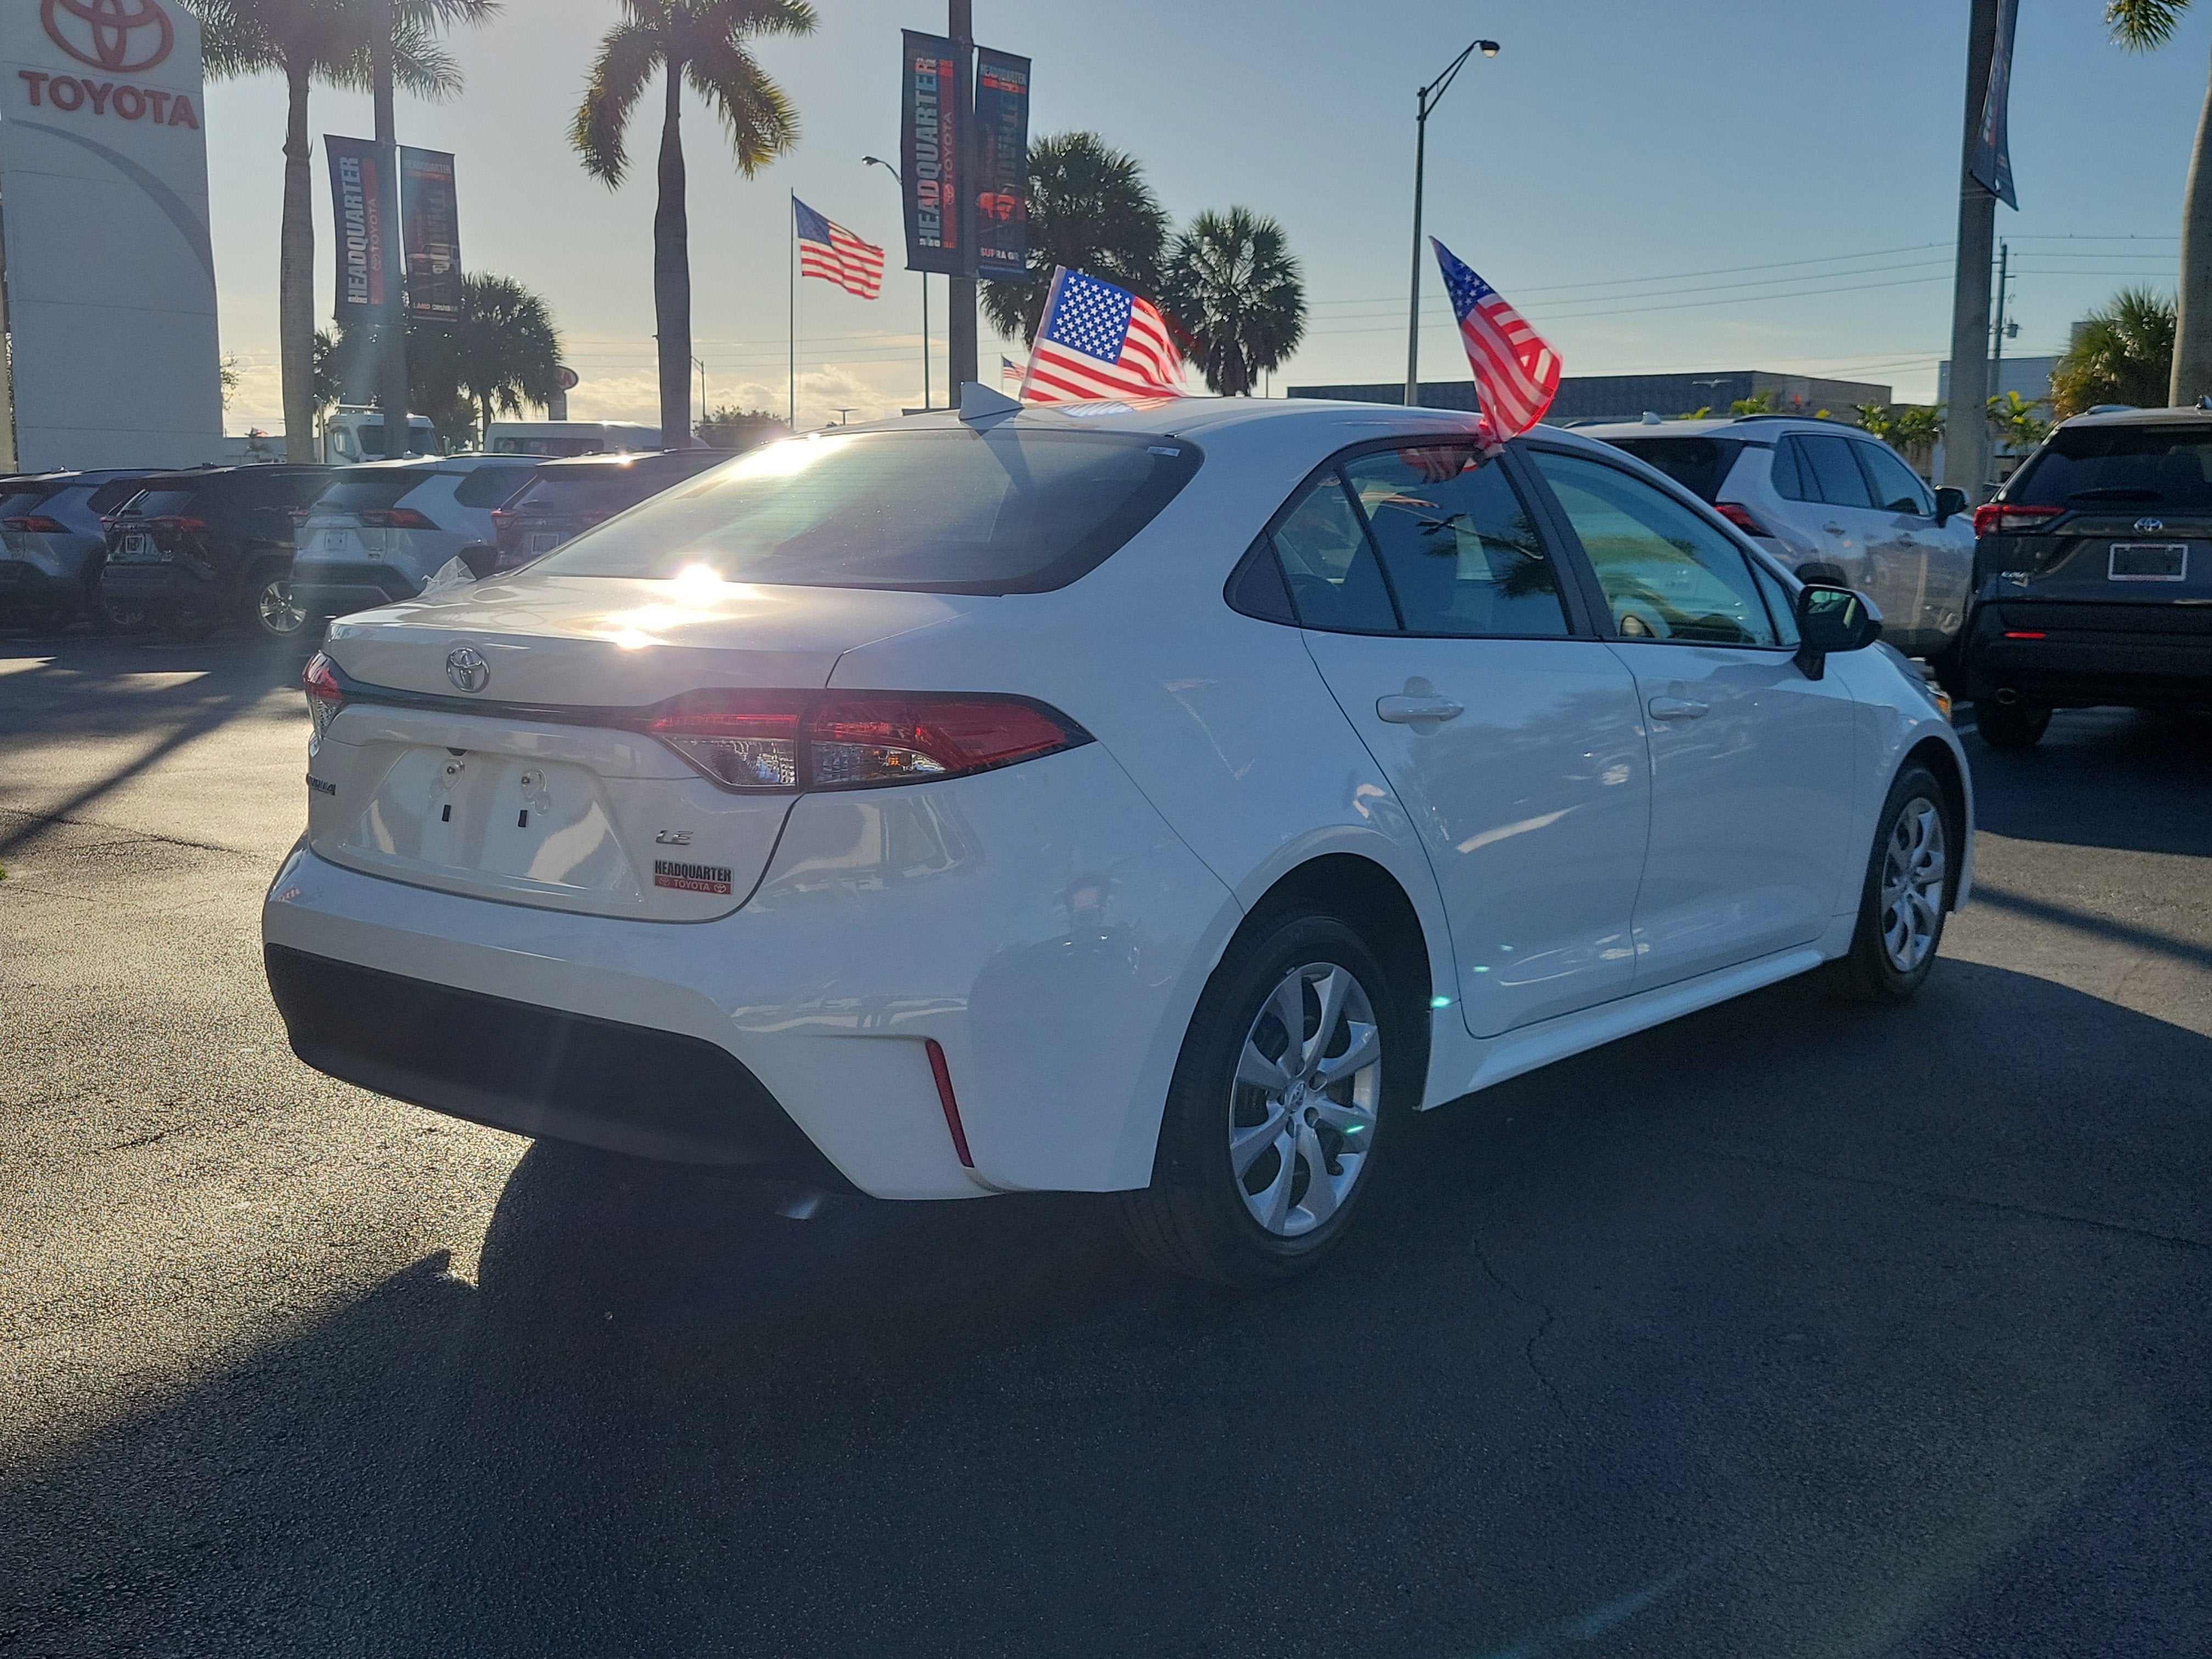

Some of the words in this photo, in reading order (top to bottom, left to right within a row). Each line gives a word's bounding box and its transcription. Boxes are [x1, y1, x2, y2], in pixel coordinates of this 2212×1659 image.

[19, 70, 199, 129] TOYOTA
[915, 58, 941, 247] HEADQUARTER
[943, 111, 953, 185] TOYOTA
[340, 157, 368, 304] HEADQUARTER
[368, 198, 380, 252] TOYOTA
[656, 830, 693, 845] LE
[654, 859, 732, 882] HEADQUARTER
[673, 879, 710, 891] TOYOTA
